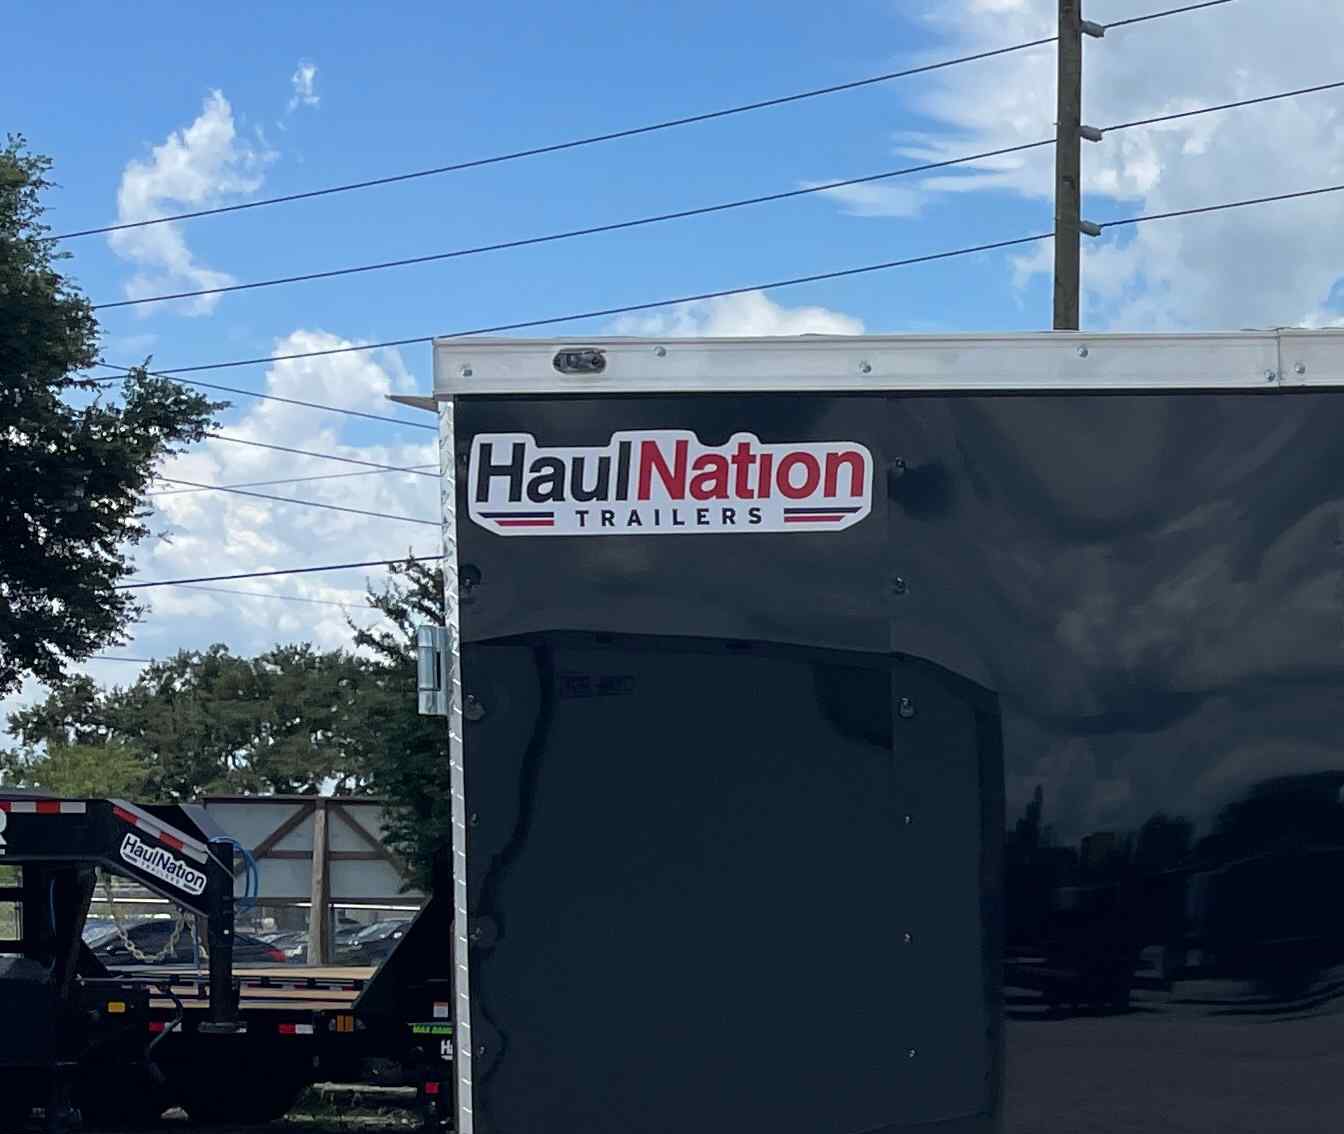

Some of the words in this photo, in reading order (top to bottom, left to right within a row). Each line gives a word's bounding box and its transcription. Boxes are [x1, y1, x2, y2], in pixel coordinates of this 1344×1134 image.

[475, 439, 866, 503] HaulNation
[575, 507, 764, 527] TRAILERS
[122, 835, 206, 889] HaulNation
